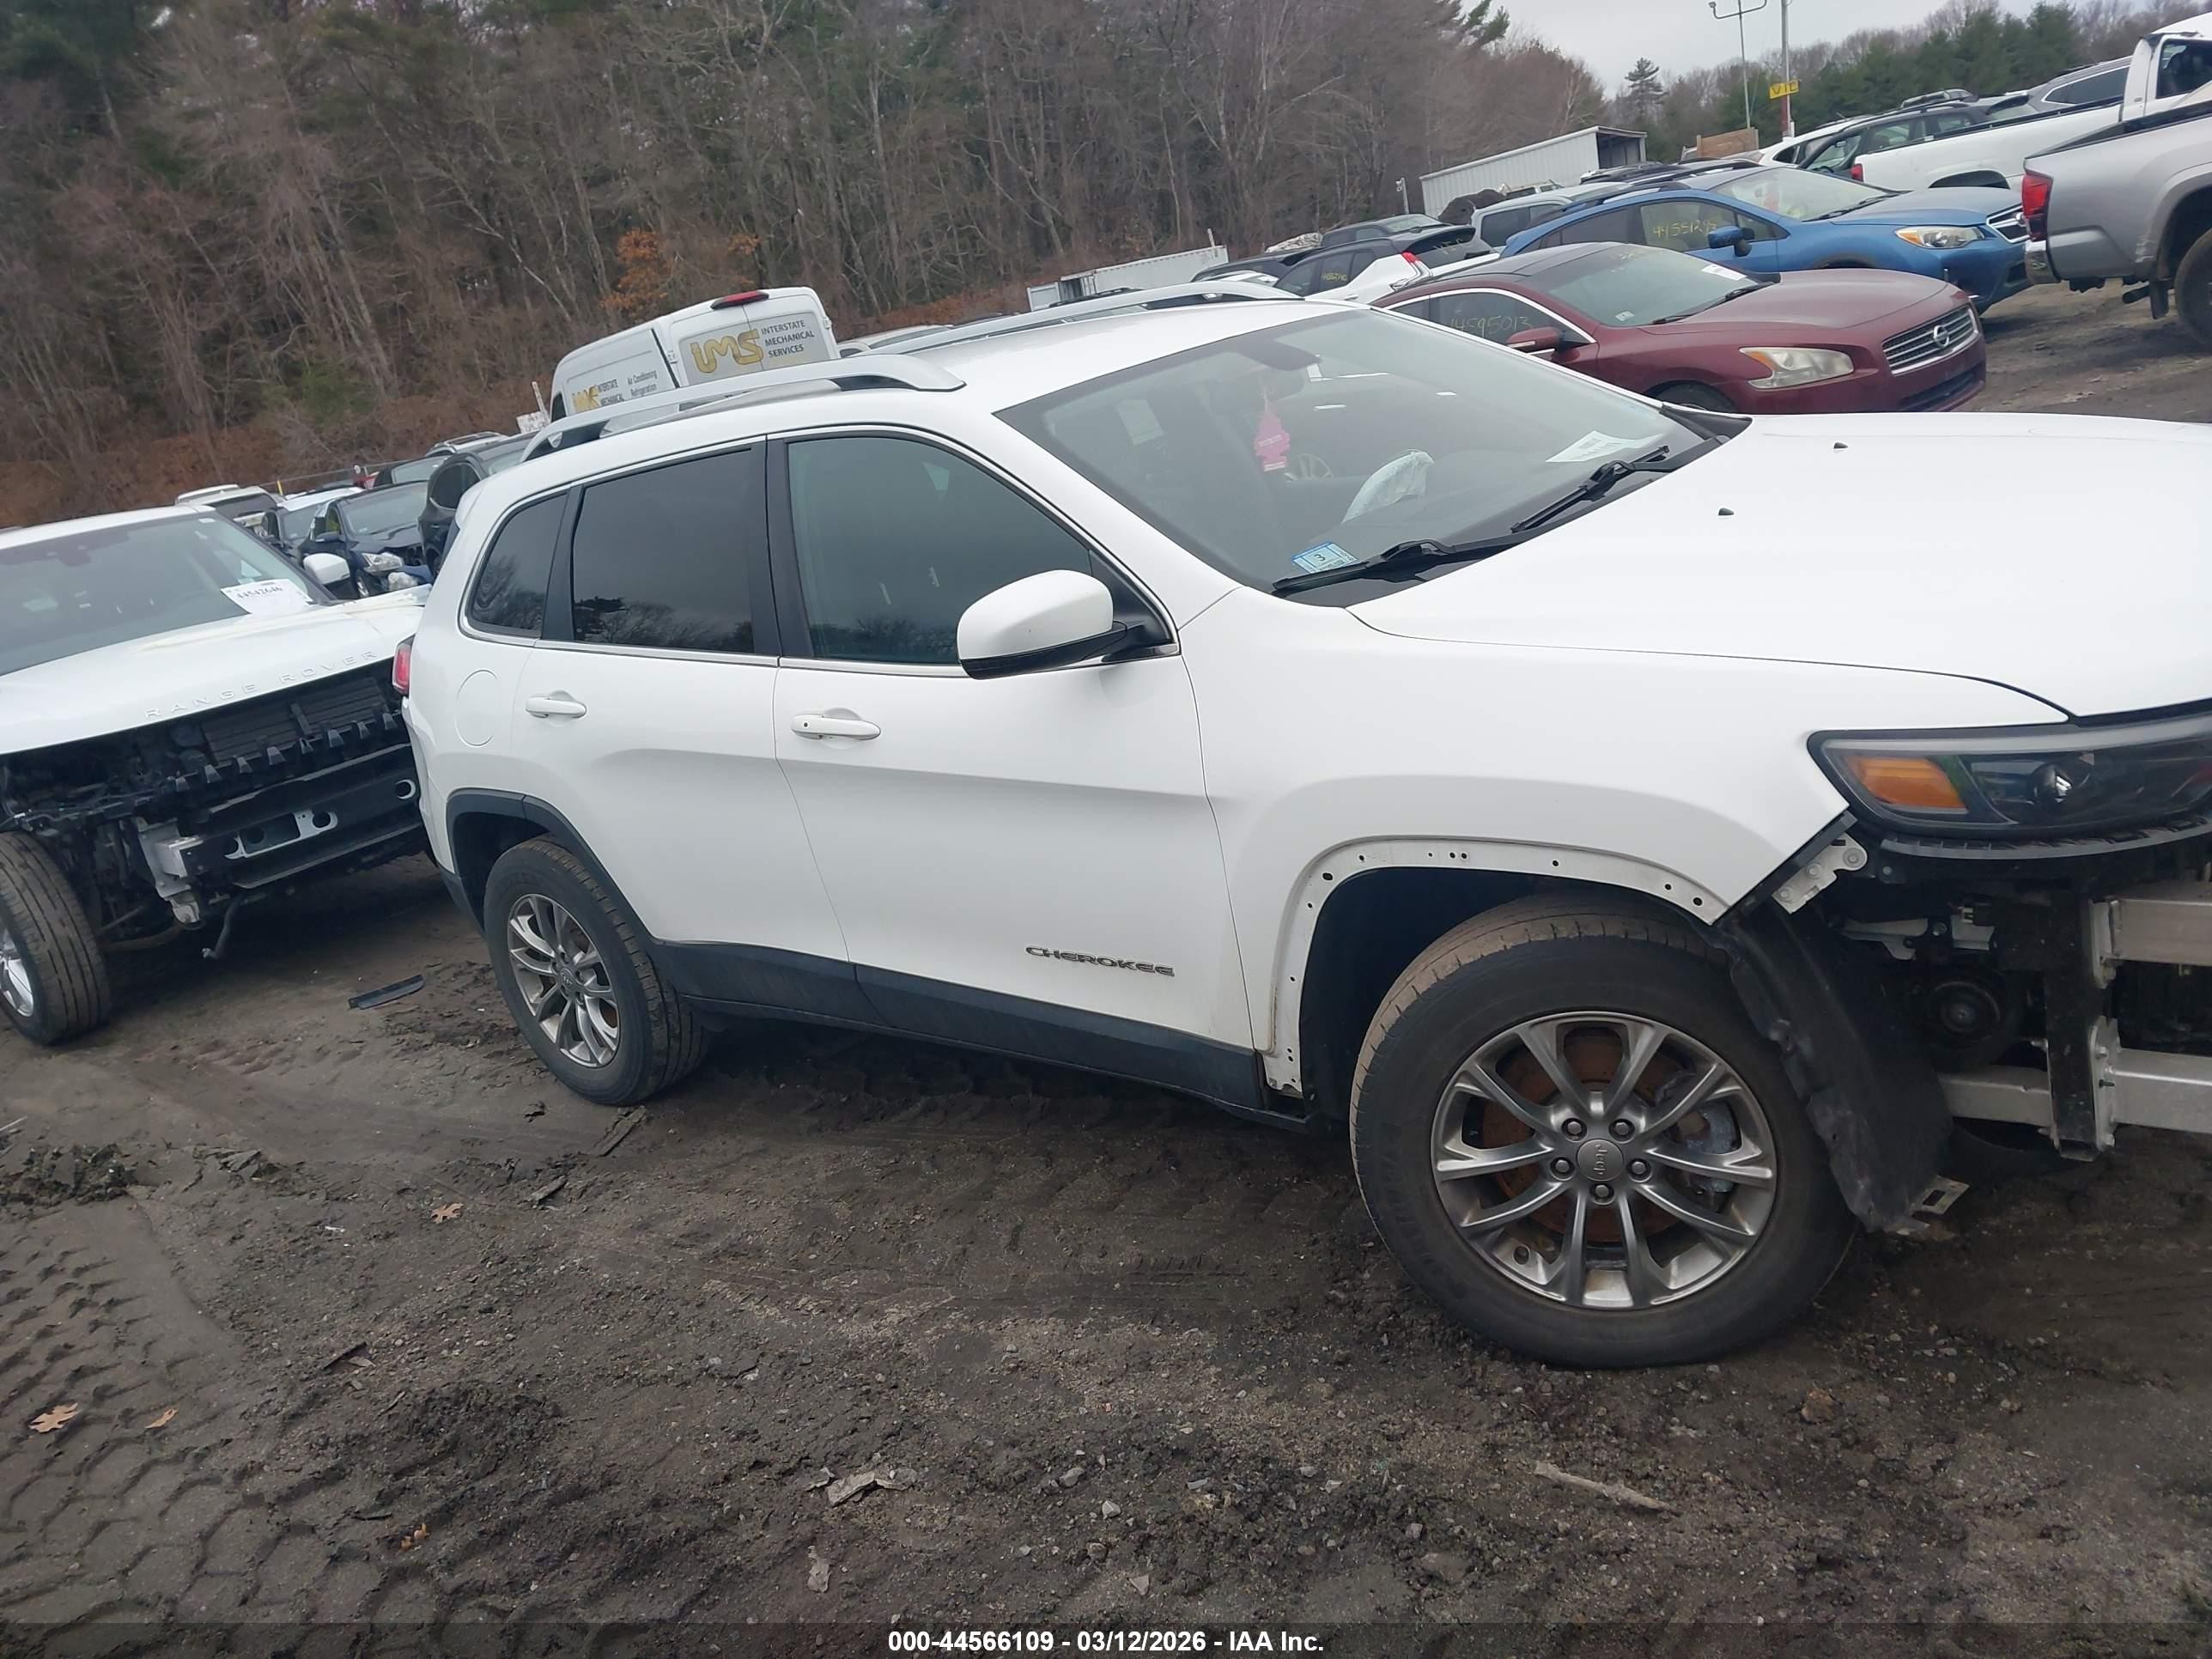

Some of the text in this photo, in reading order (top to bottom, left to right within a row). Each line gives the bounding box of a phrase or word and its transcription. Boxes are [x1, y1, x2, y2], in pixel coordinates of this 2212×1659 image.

[761, 319, 805, 336] INTERSTATE
[764, 331, 815, 347] MECHANICAL
[768, 343, 805, 358] SERVICES
[143, 650, 378, 718] RANGE ROVER
[1025, 946, 1175, 977] CHEROKEE
[1593, 1143, 1609, 1176] Jeep
